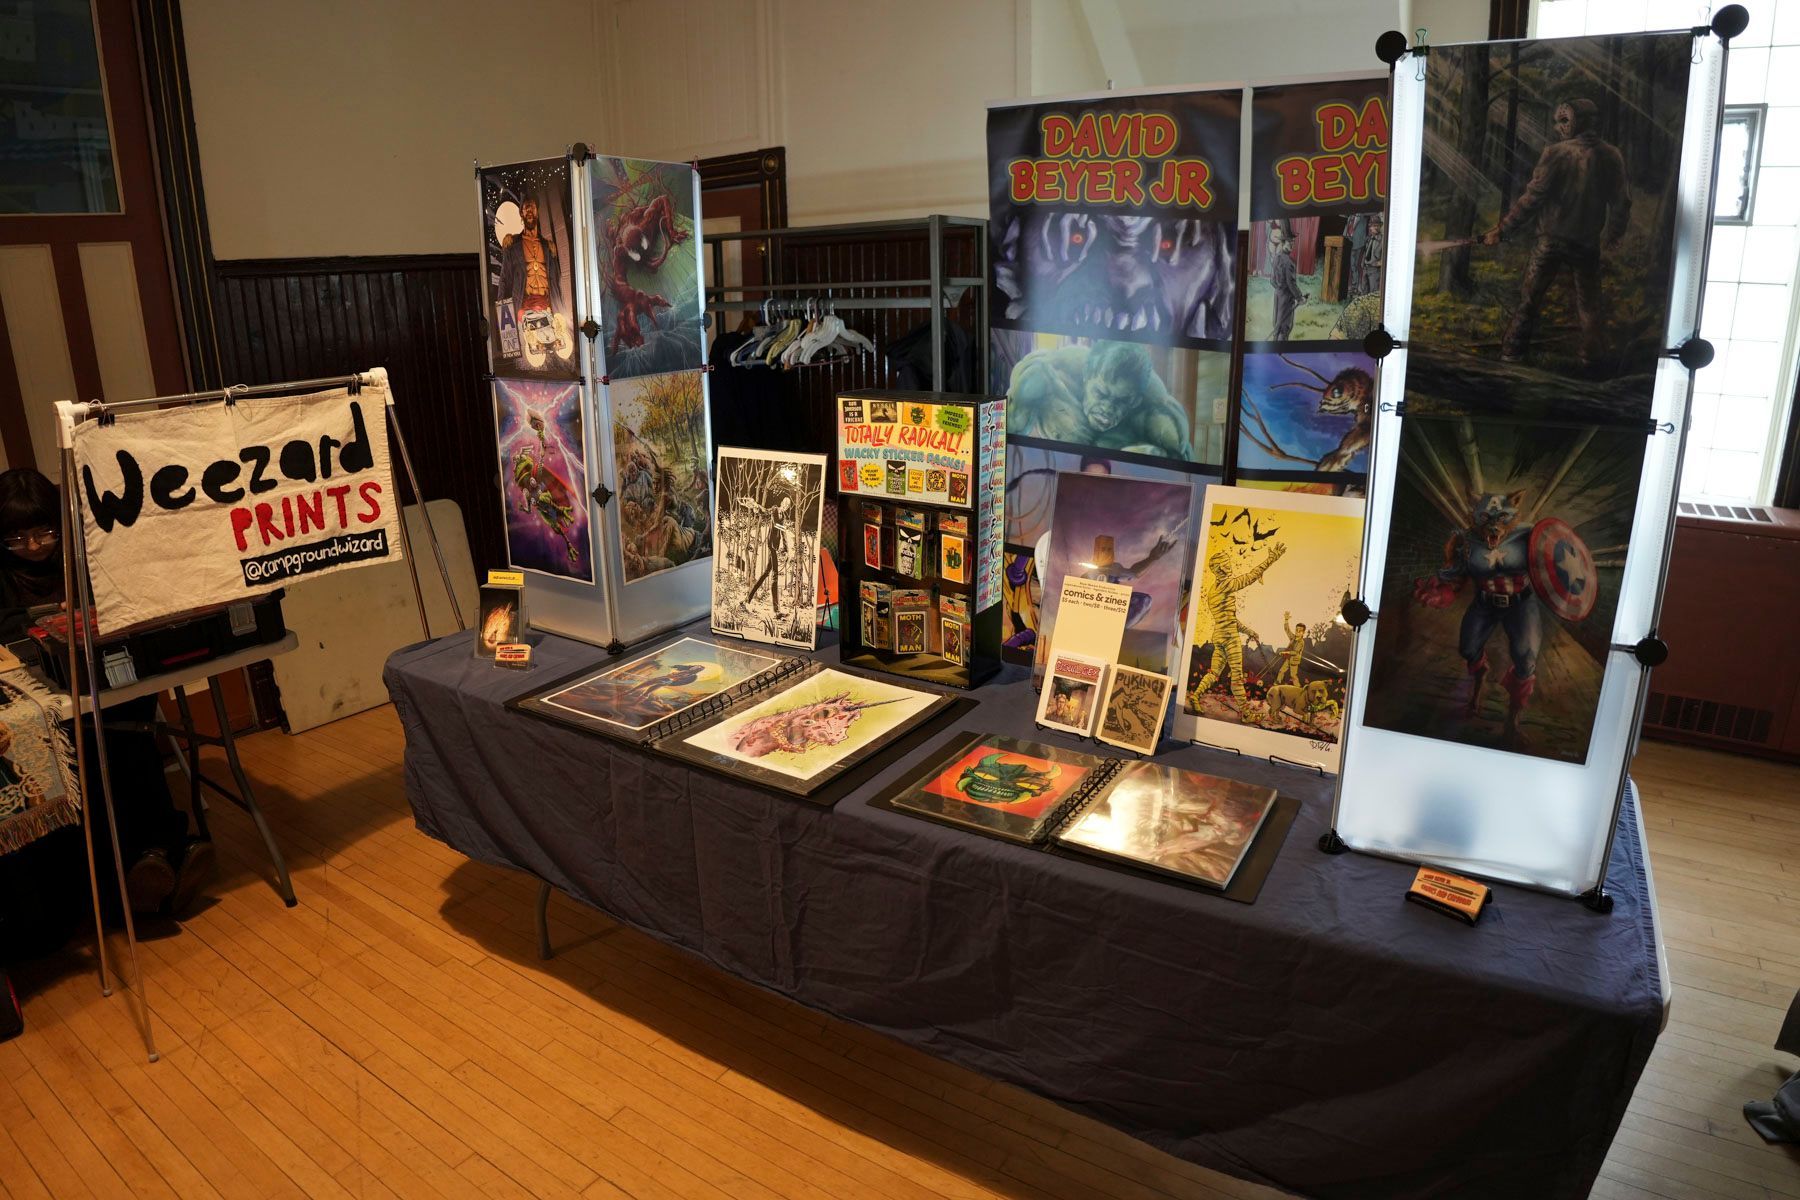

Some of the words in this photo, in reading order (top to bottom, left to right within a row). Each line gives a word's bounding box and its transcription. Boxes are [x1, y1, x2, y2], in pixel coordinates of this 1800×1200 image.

[1042, 113, 1178, 158] DAVID
[1009, 159, 1144, 206] BEYER
[1151, 160, 1213, 208] JR
[501, 304, 515, 330] A
[845, 425, 894, 447] TOTALLY
[899, 426, 963, 455] RADICAL!
[83, 402, 373, 533] Weezard
[844, 448, 881, 460] WACKY
[882, 449, 924, 462] STICKER
[927, 453, 966, 472] PACKS!
[950, 495, 966, 503] MAN
[230, 482, 382, 552] PRINTS
[245, 533, 383, 580] @campgroundwizard
[1063, 589, 1094, 601] comics
[1095, 593, 1103, 602] &
[1104, 594, 1127, 607] zines
[944, 621, 959, 629] MOTH
[945, 653, 961, 662] MAN
